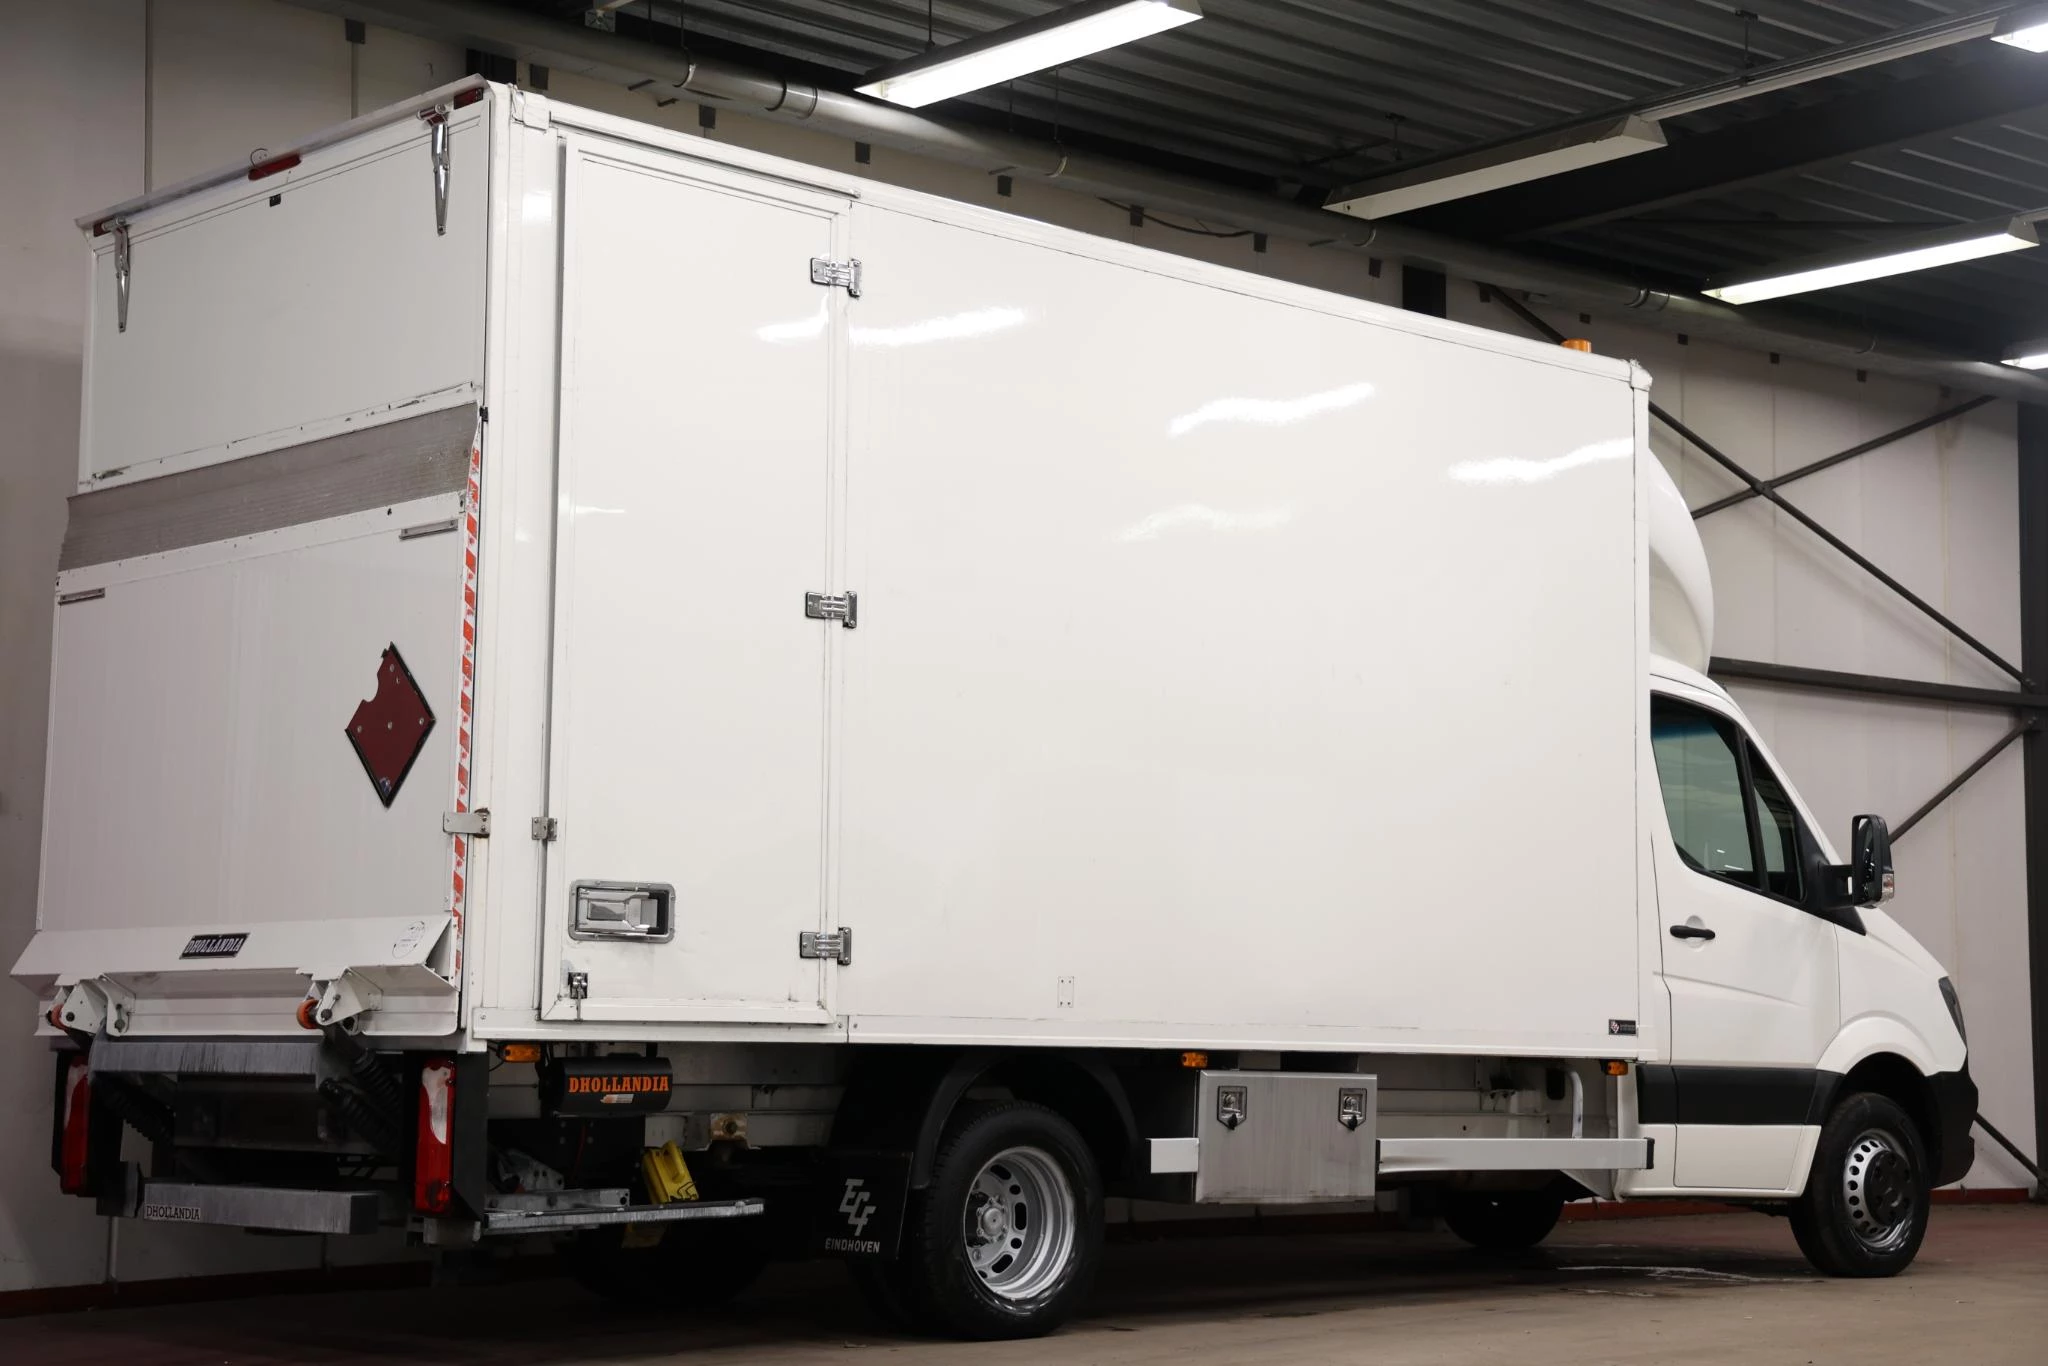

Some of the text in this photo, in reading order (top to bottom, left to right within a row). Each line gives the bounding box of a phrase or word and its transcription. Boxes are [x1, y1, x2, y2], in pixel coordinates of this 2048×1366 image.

[184, 938, 245, 953] DHOLLANDIA
[568, 1076, 669, 1093] DHOLLANDIA
[146, 1205, 200, 1220] DHOLLANDIA
[825, 1237, 881, 1253] EINDHOVEN
